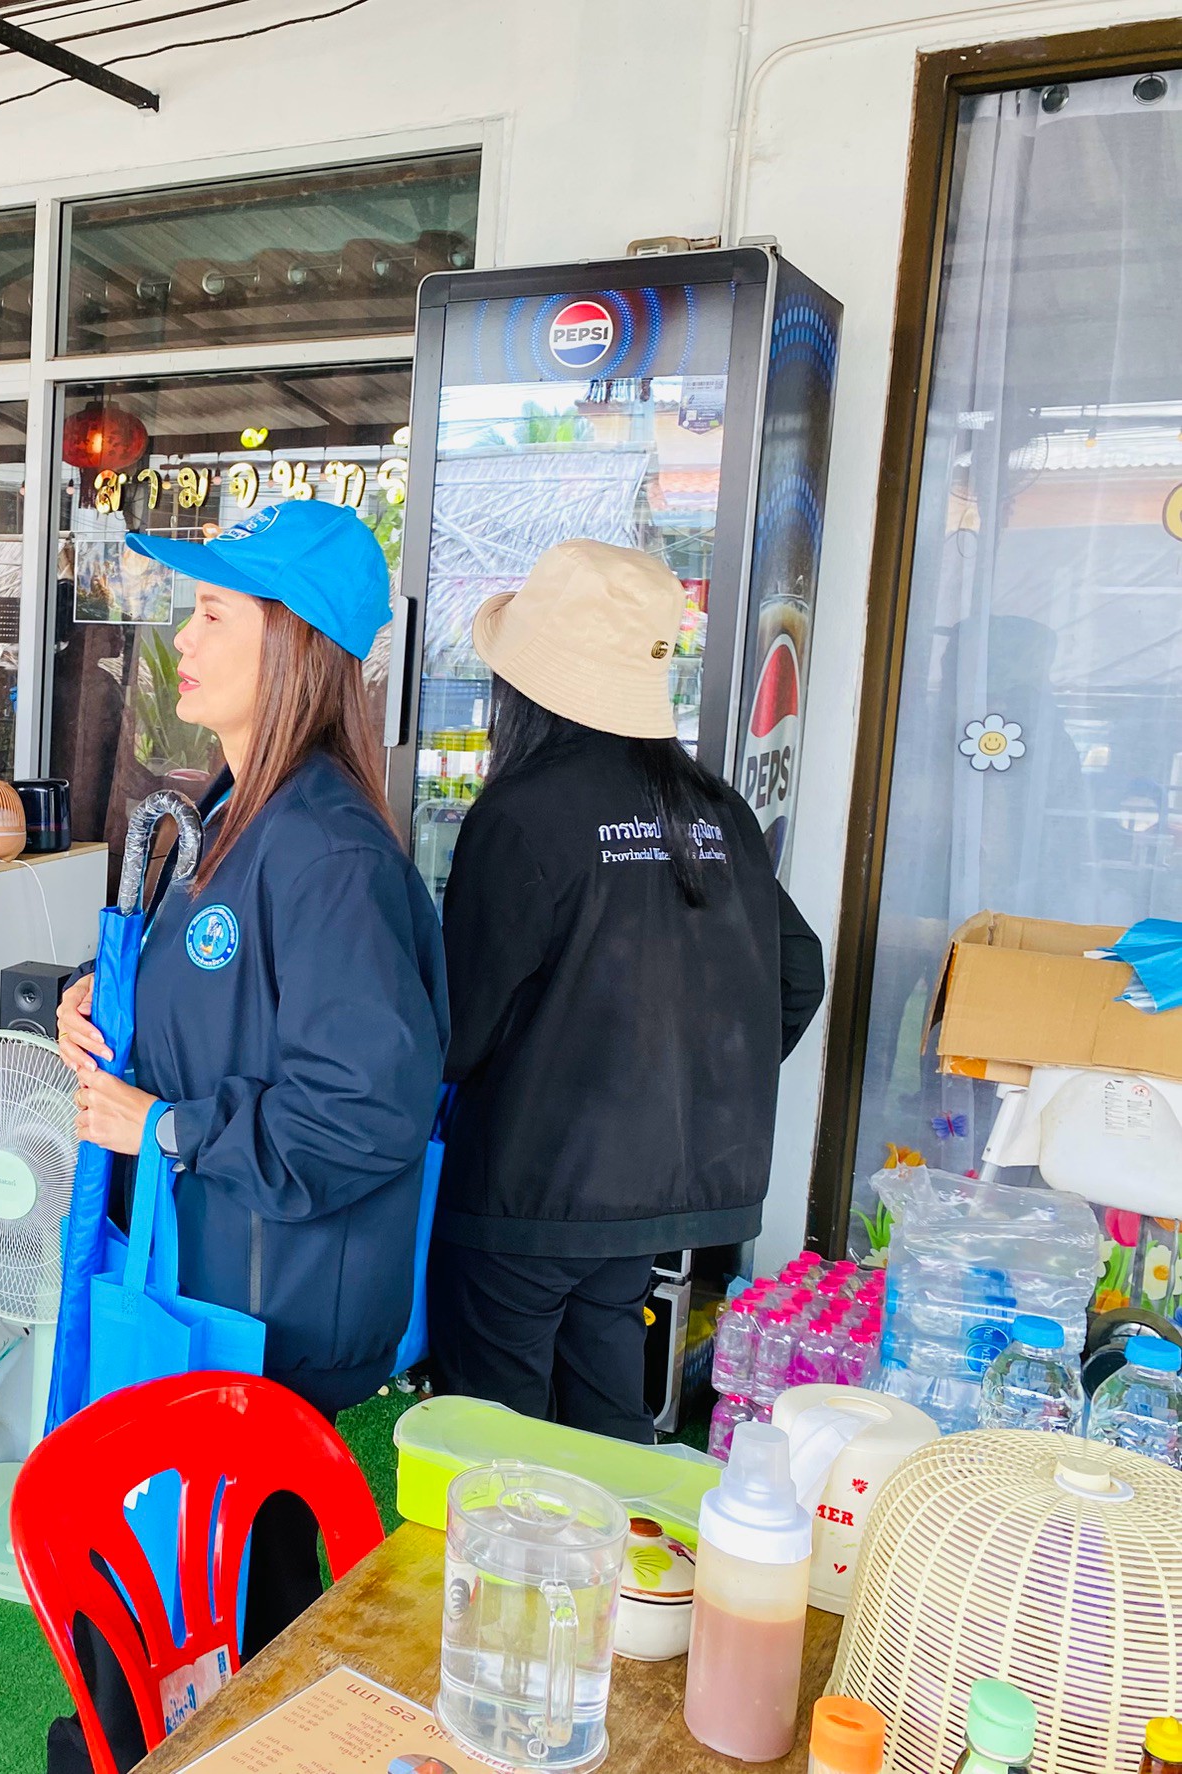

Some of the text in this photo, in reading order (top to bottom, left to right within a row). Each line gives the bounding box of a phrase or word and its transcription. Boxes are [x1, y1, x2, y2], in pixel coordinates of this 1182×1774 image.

[553, 326, 608, 343] PEPSI
[601, 847, 653, 863] Provincial
[346, 1683, 416, 1723] 25 บาท
